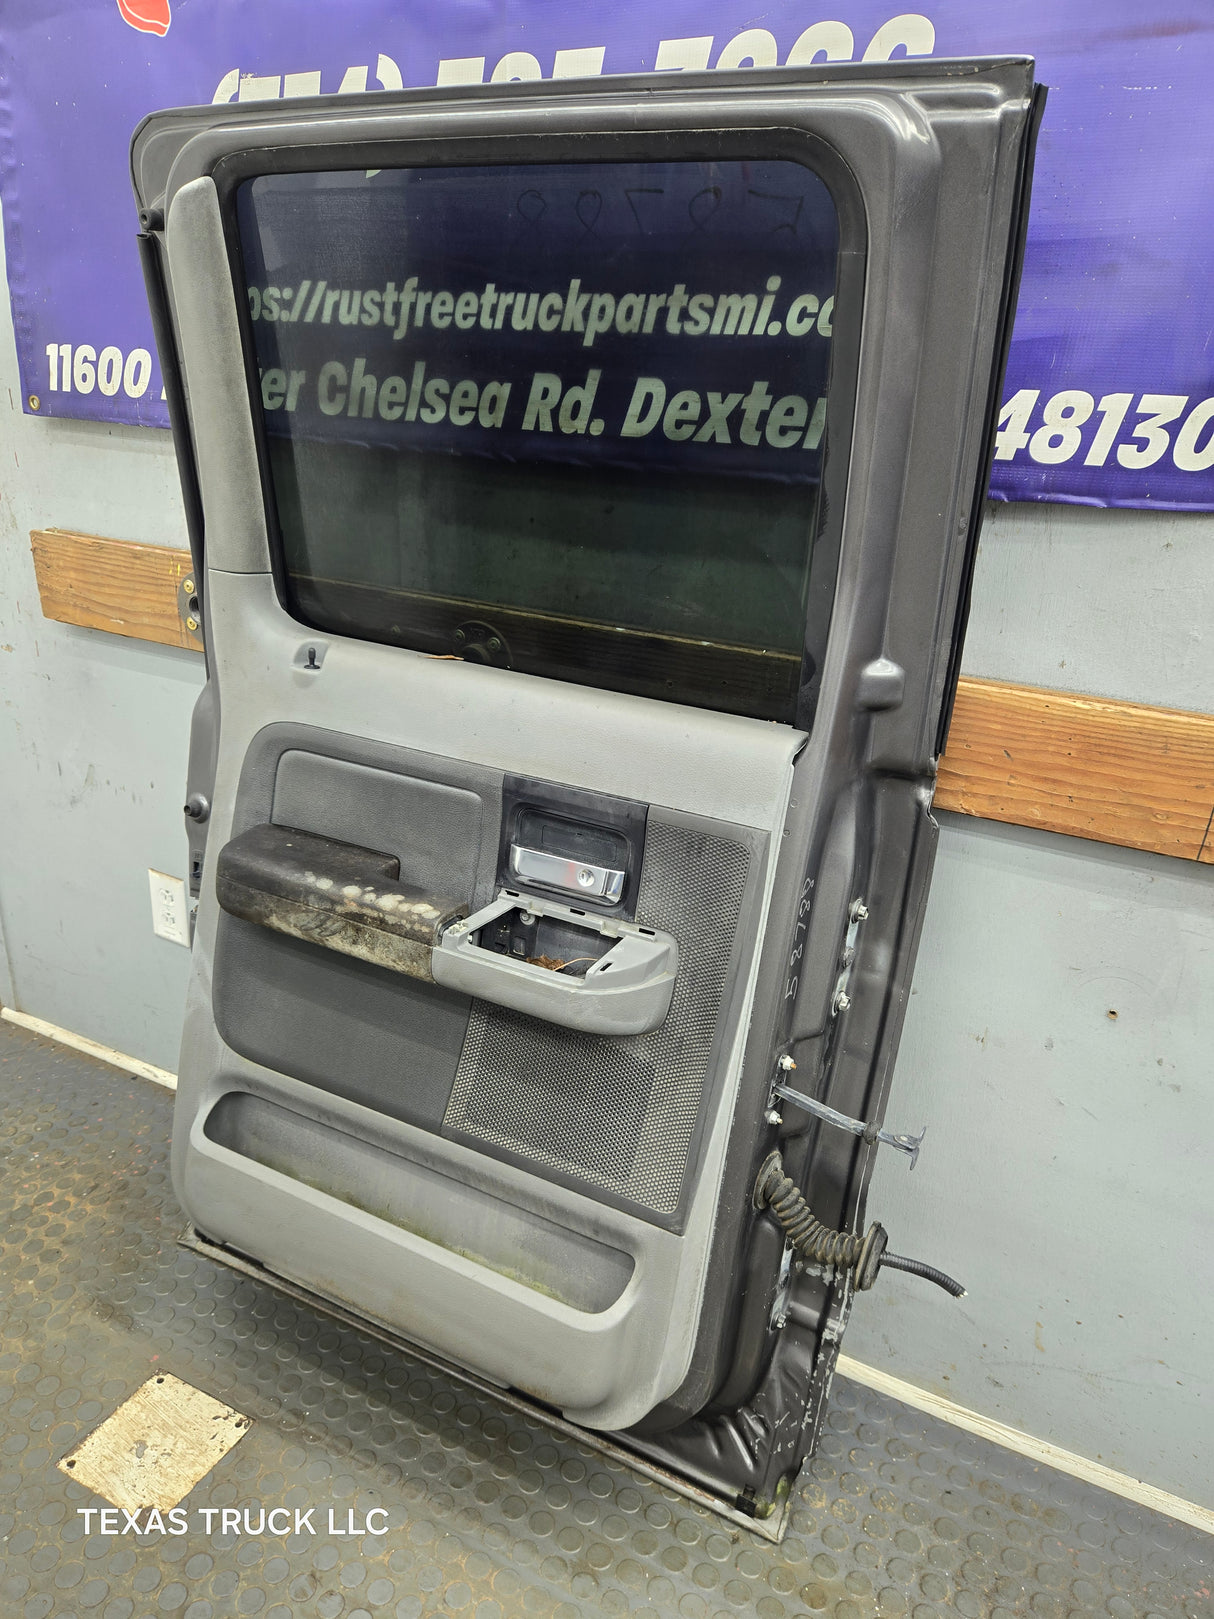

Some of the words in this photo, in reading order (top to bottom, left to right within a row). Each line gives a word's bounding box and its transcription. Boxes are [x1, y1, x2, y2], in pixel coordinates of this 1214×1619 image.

[46, 343, 152, 398] 11600
[258, 366, 306, 411] er
[318, 357, 512, 428] Chelsea
[522, 370, 605, 436] Rd.
[620, 377, 828, 450] Dexter
[994, 389, 1214, 472] 48130
